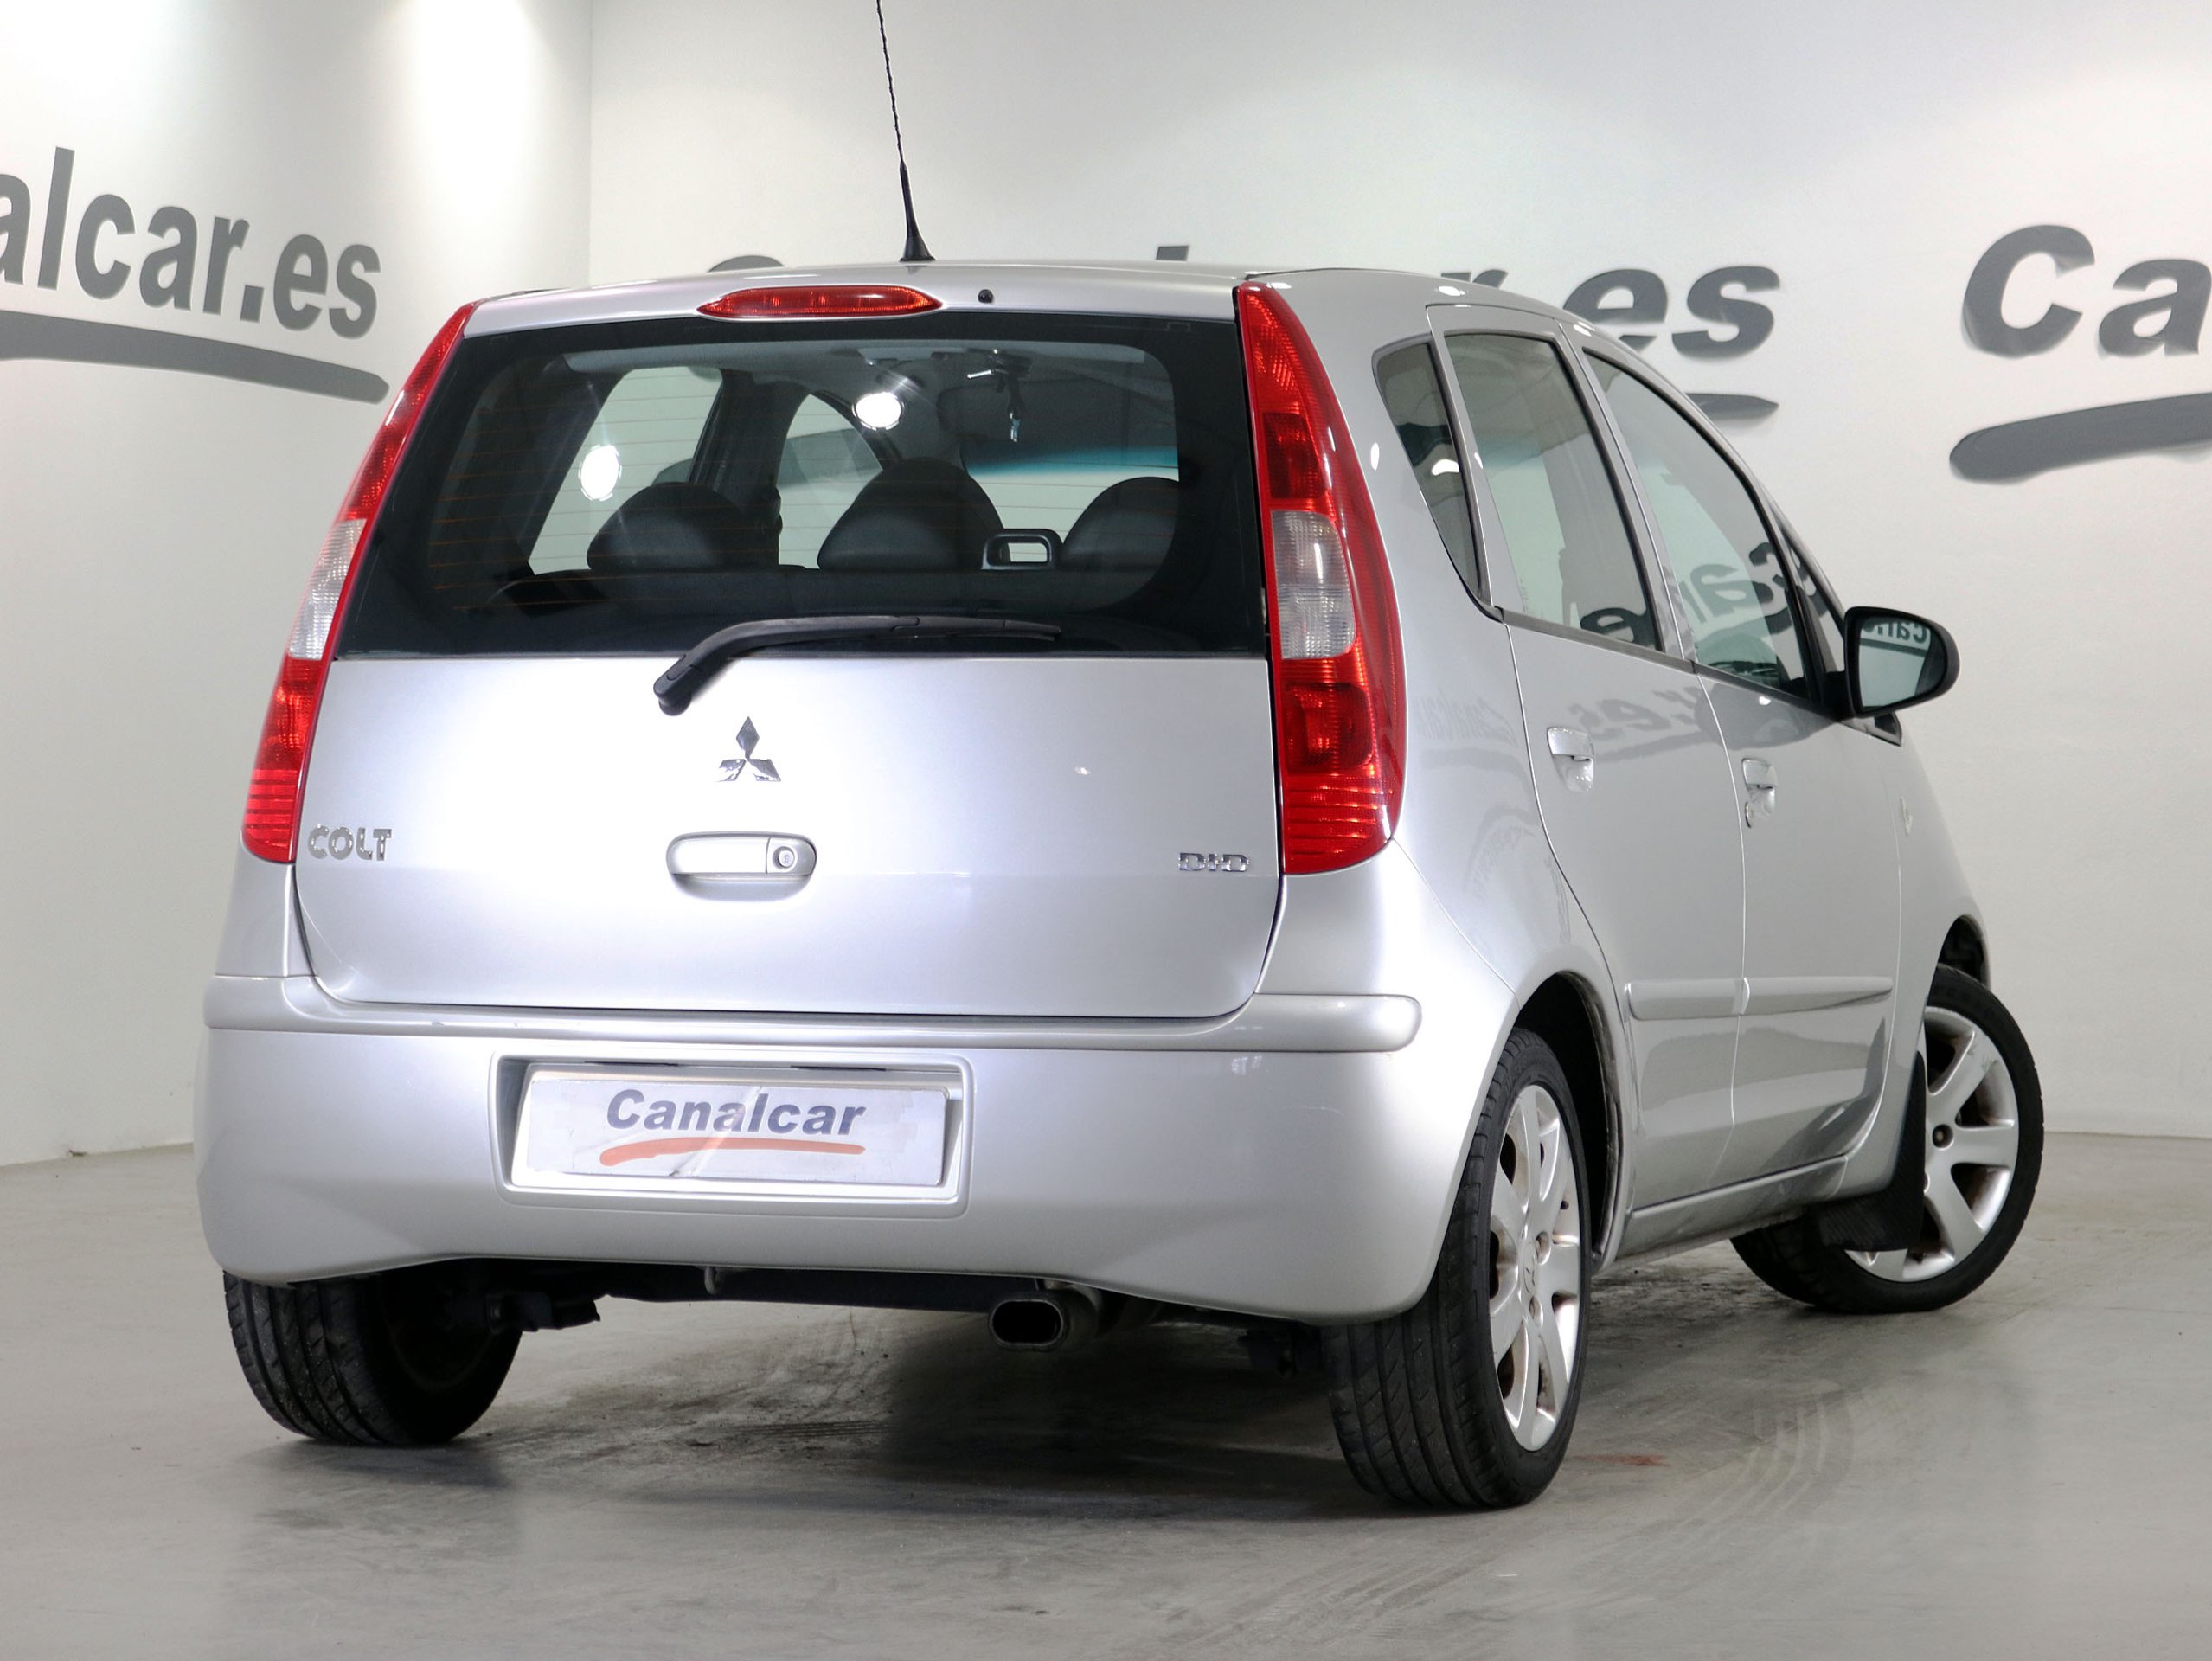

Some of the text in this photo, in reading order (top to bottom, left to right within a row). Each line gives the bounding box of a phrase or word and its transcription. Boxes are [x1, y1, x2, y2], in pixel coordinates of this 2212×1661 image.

[1962, 224, 2212, 359] Ca
[307, 824, 392, 861] COLT
[606, 1088, 866, 1136] Canalcar
